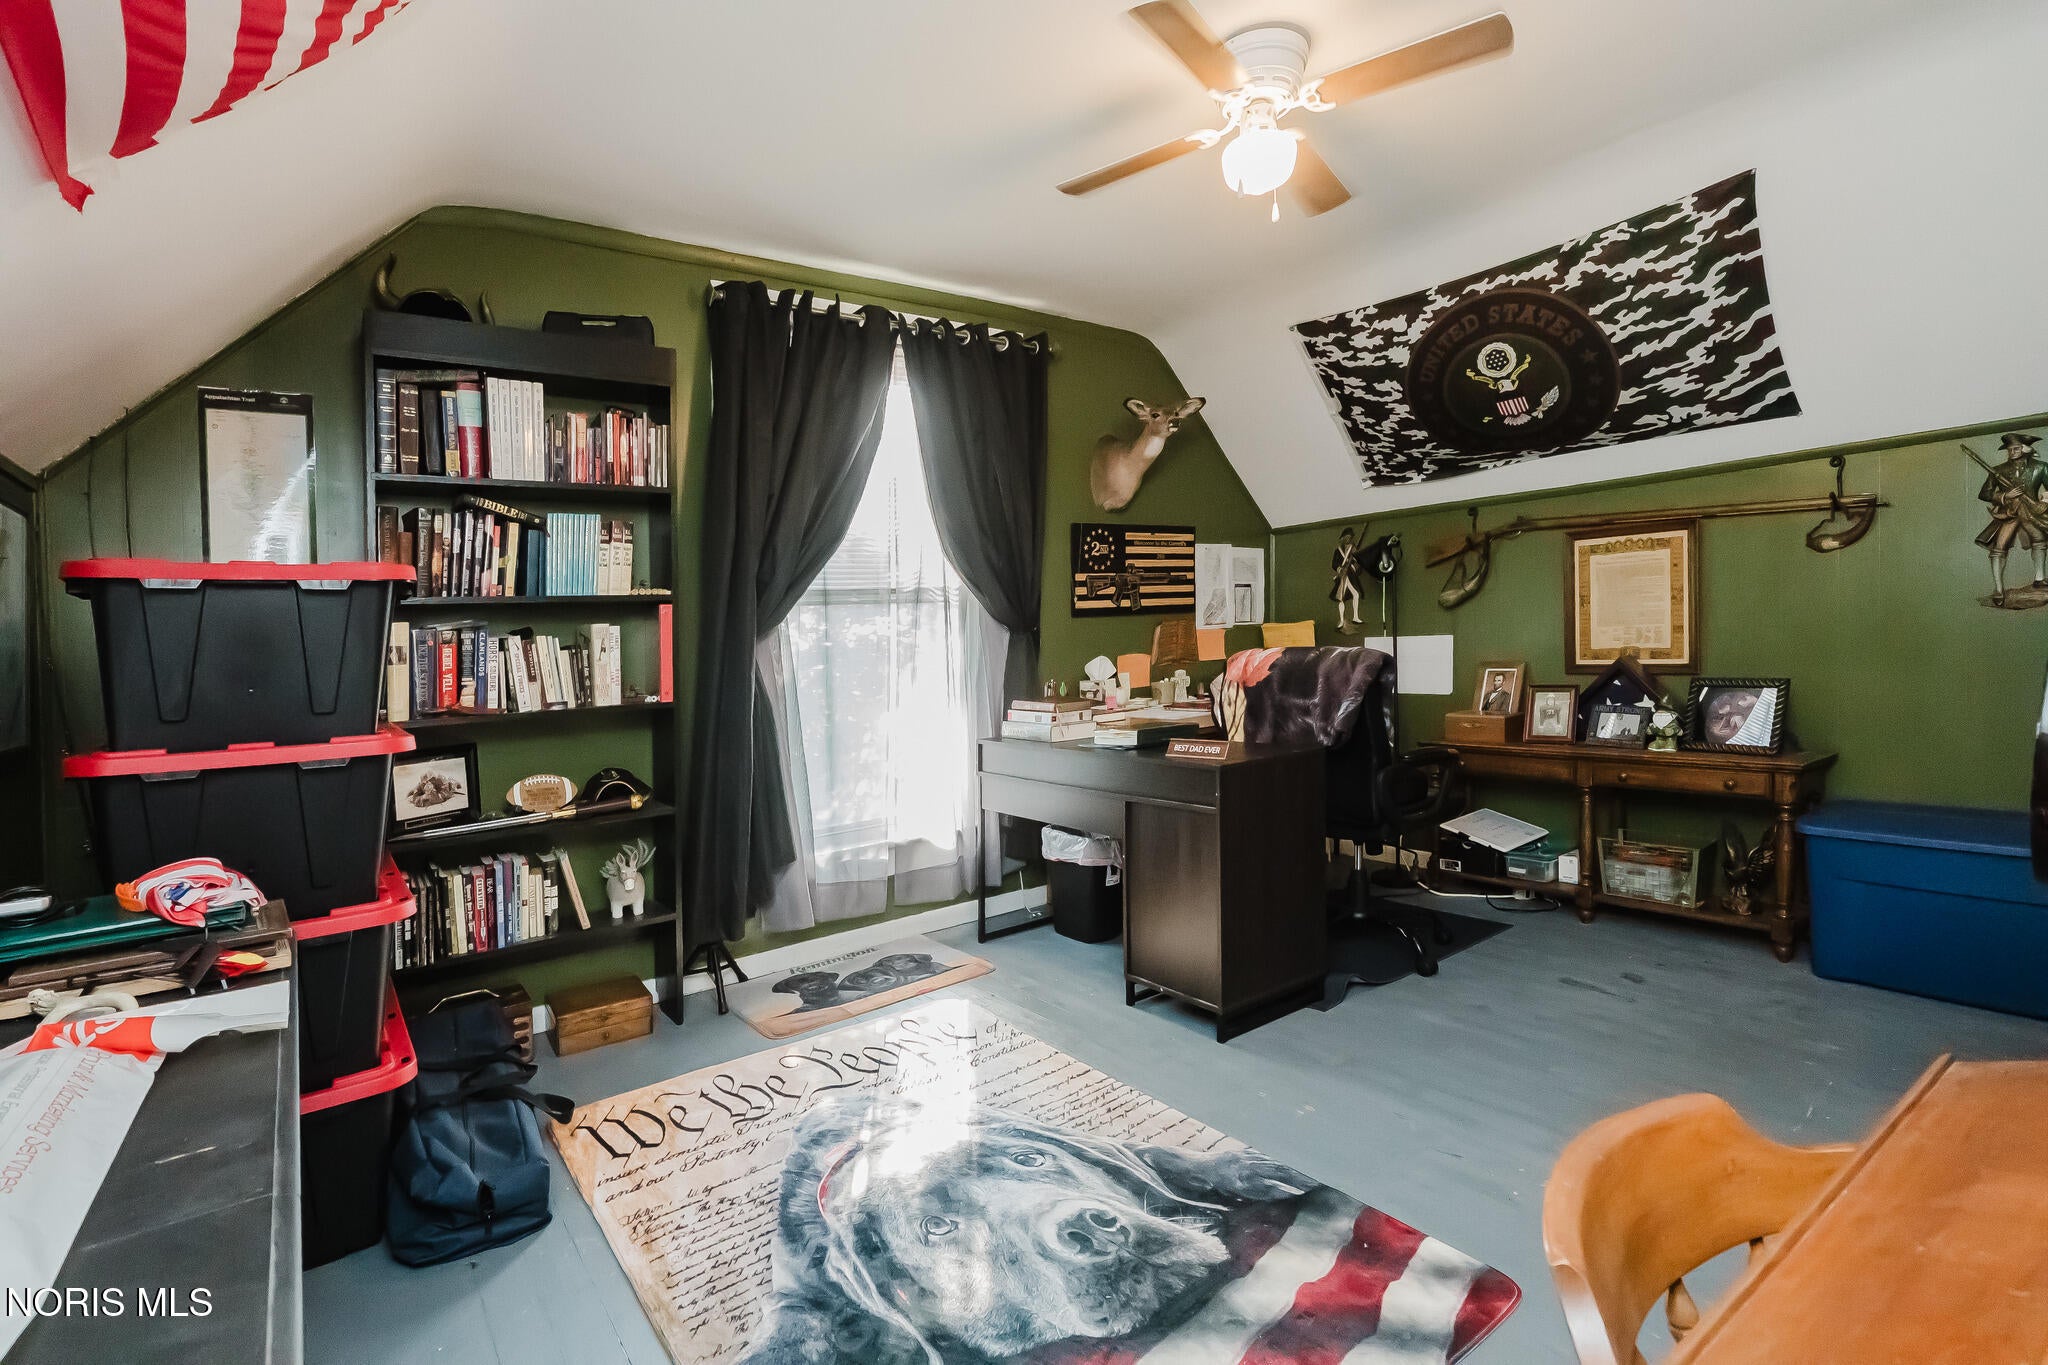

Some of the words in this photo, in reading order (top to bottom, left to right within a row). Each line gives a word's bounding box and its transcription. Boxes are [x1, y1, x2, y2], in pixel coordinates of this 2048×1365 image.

[1420, 314, 1479, 382] UNITED
[1488, 303, 1583, 345] STATES
[482, 499, 519, 518] BIBLE
[488, 640, 498, 664] HORSE
[442, 673, 453, 693] YELL
[1173, 744, 1188, 753] BEST
[1189, 745, 1203, 754] DAD
[1204, 746, 1221, 754] EVER
